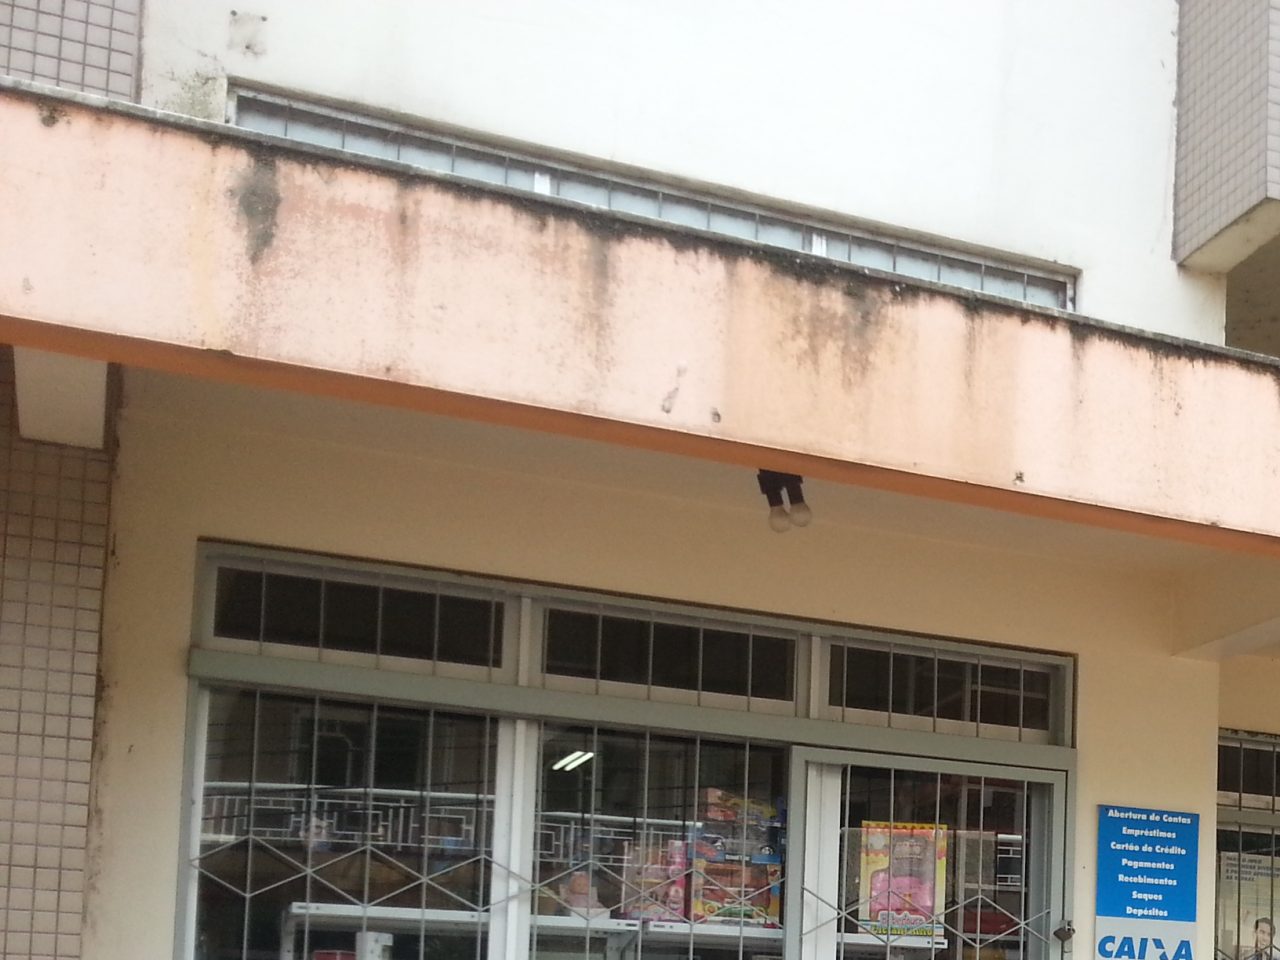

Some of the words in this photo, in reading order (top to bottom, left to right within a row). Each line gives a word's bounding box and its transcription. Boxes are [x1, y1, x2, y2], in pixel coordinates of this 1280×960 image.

[1107, 808, 1147, 821] Abertura
[1149, 813, 1161, 822] de
[1162, 814, 1192, 825] Contas
[1122, 826, 1177, 839] Empréstimos
[1110, 841, 1140, 852] Cartão
[1141, 844, 1153, 853] de
[1155, 844, 1187, 855] Crédito
[1121, 858, 1175, 870] Pagamentos
[1118, 874, 1178, 886] Recebimentos
[1131, 890, 1163, 902] Saques
[1125, 906, 1169, 917] Depósitos
